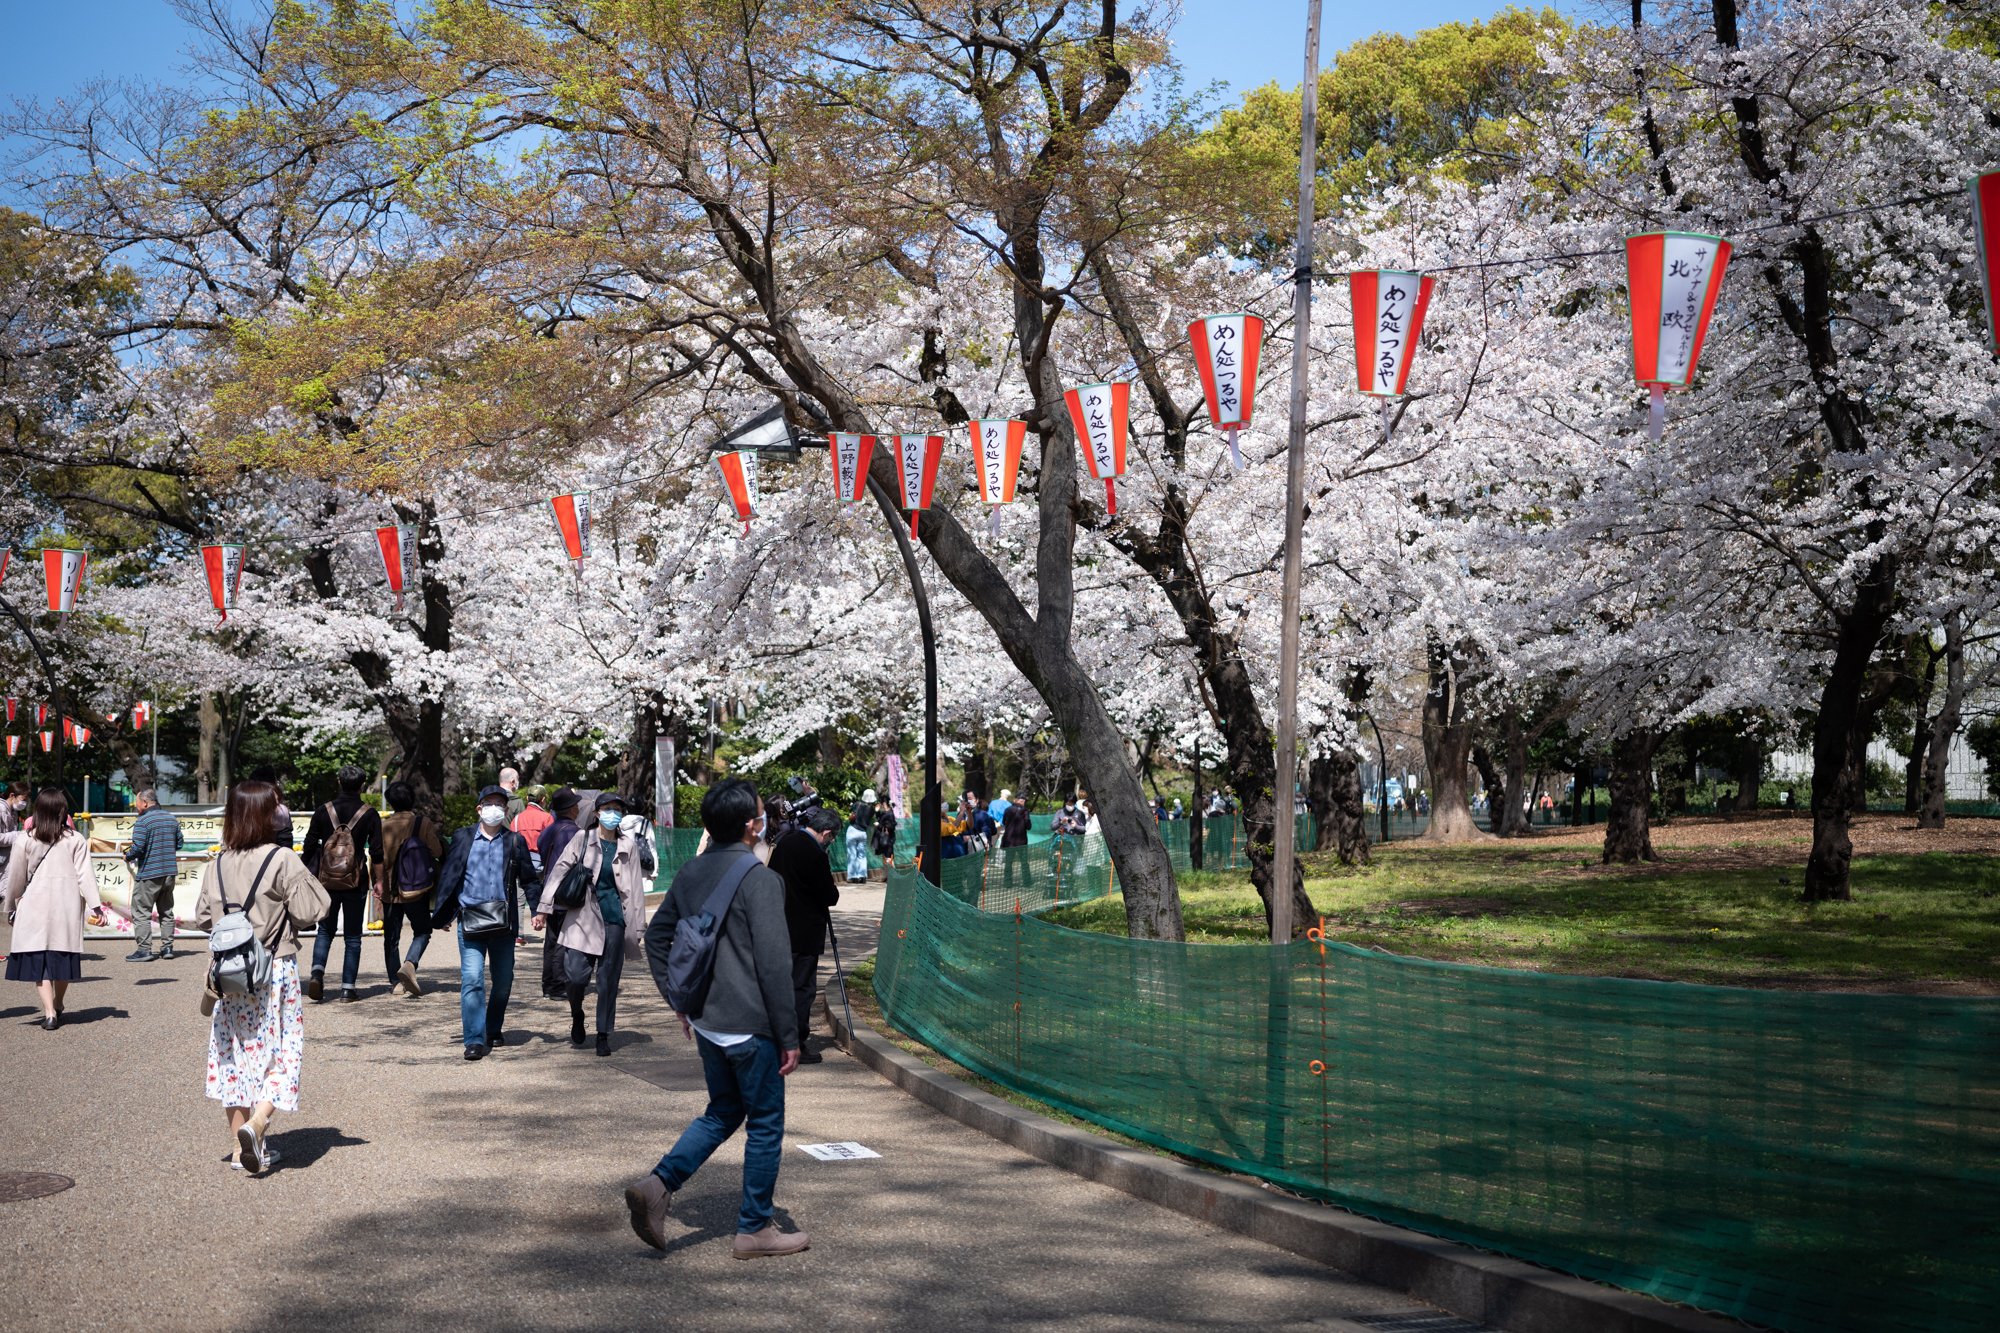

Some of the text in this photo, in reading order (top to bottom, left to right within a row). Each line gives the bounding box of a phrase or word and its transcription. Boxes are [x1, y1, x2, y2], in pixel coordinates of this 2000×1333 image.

[1662, 260, 1689, 329] 北欧
[1213, 324, 1238, 412] めん処つるや
[1378, 285, 1406, 387] めん処つるや
[985, 428, 1001, 498] めん処つるや
[1085, 395, 1111, 468] めん処つるや
[904, 442, 920, 503] めん処つるや
[96, 861, 119, 872] カン
